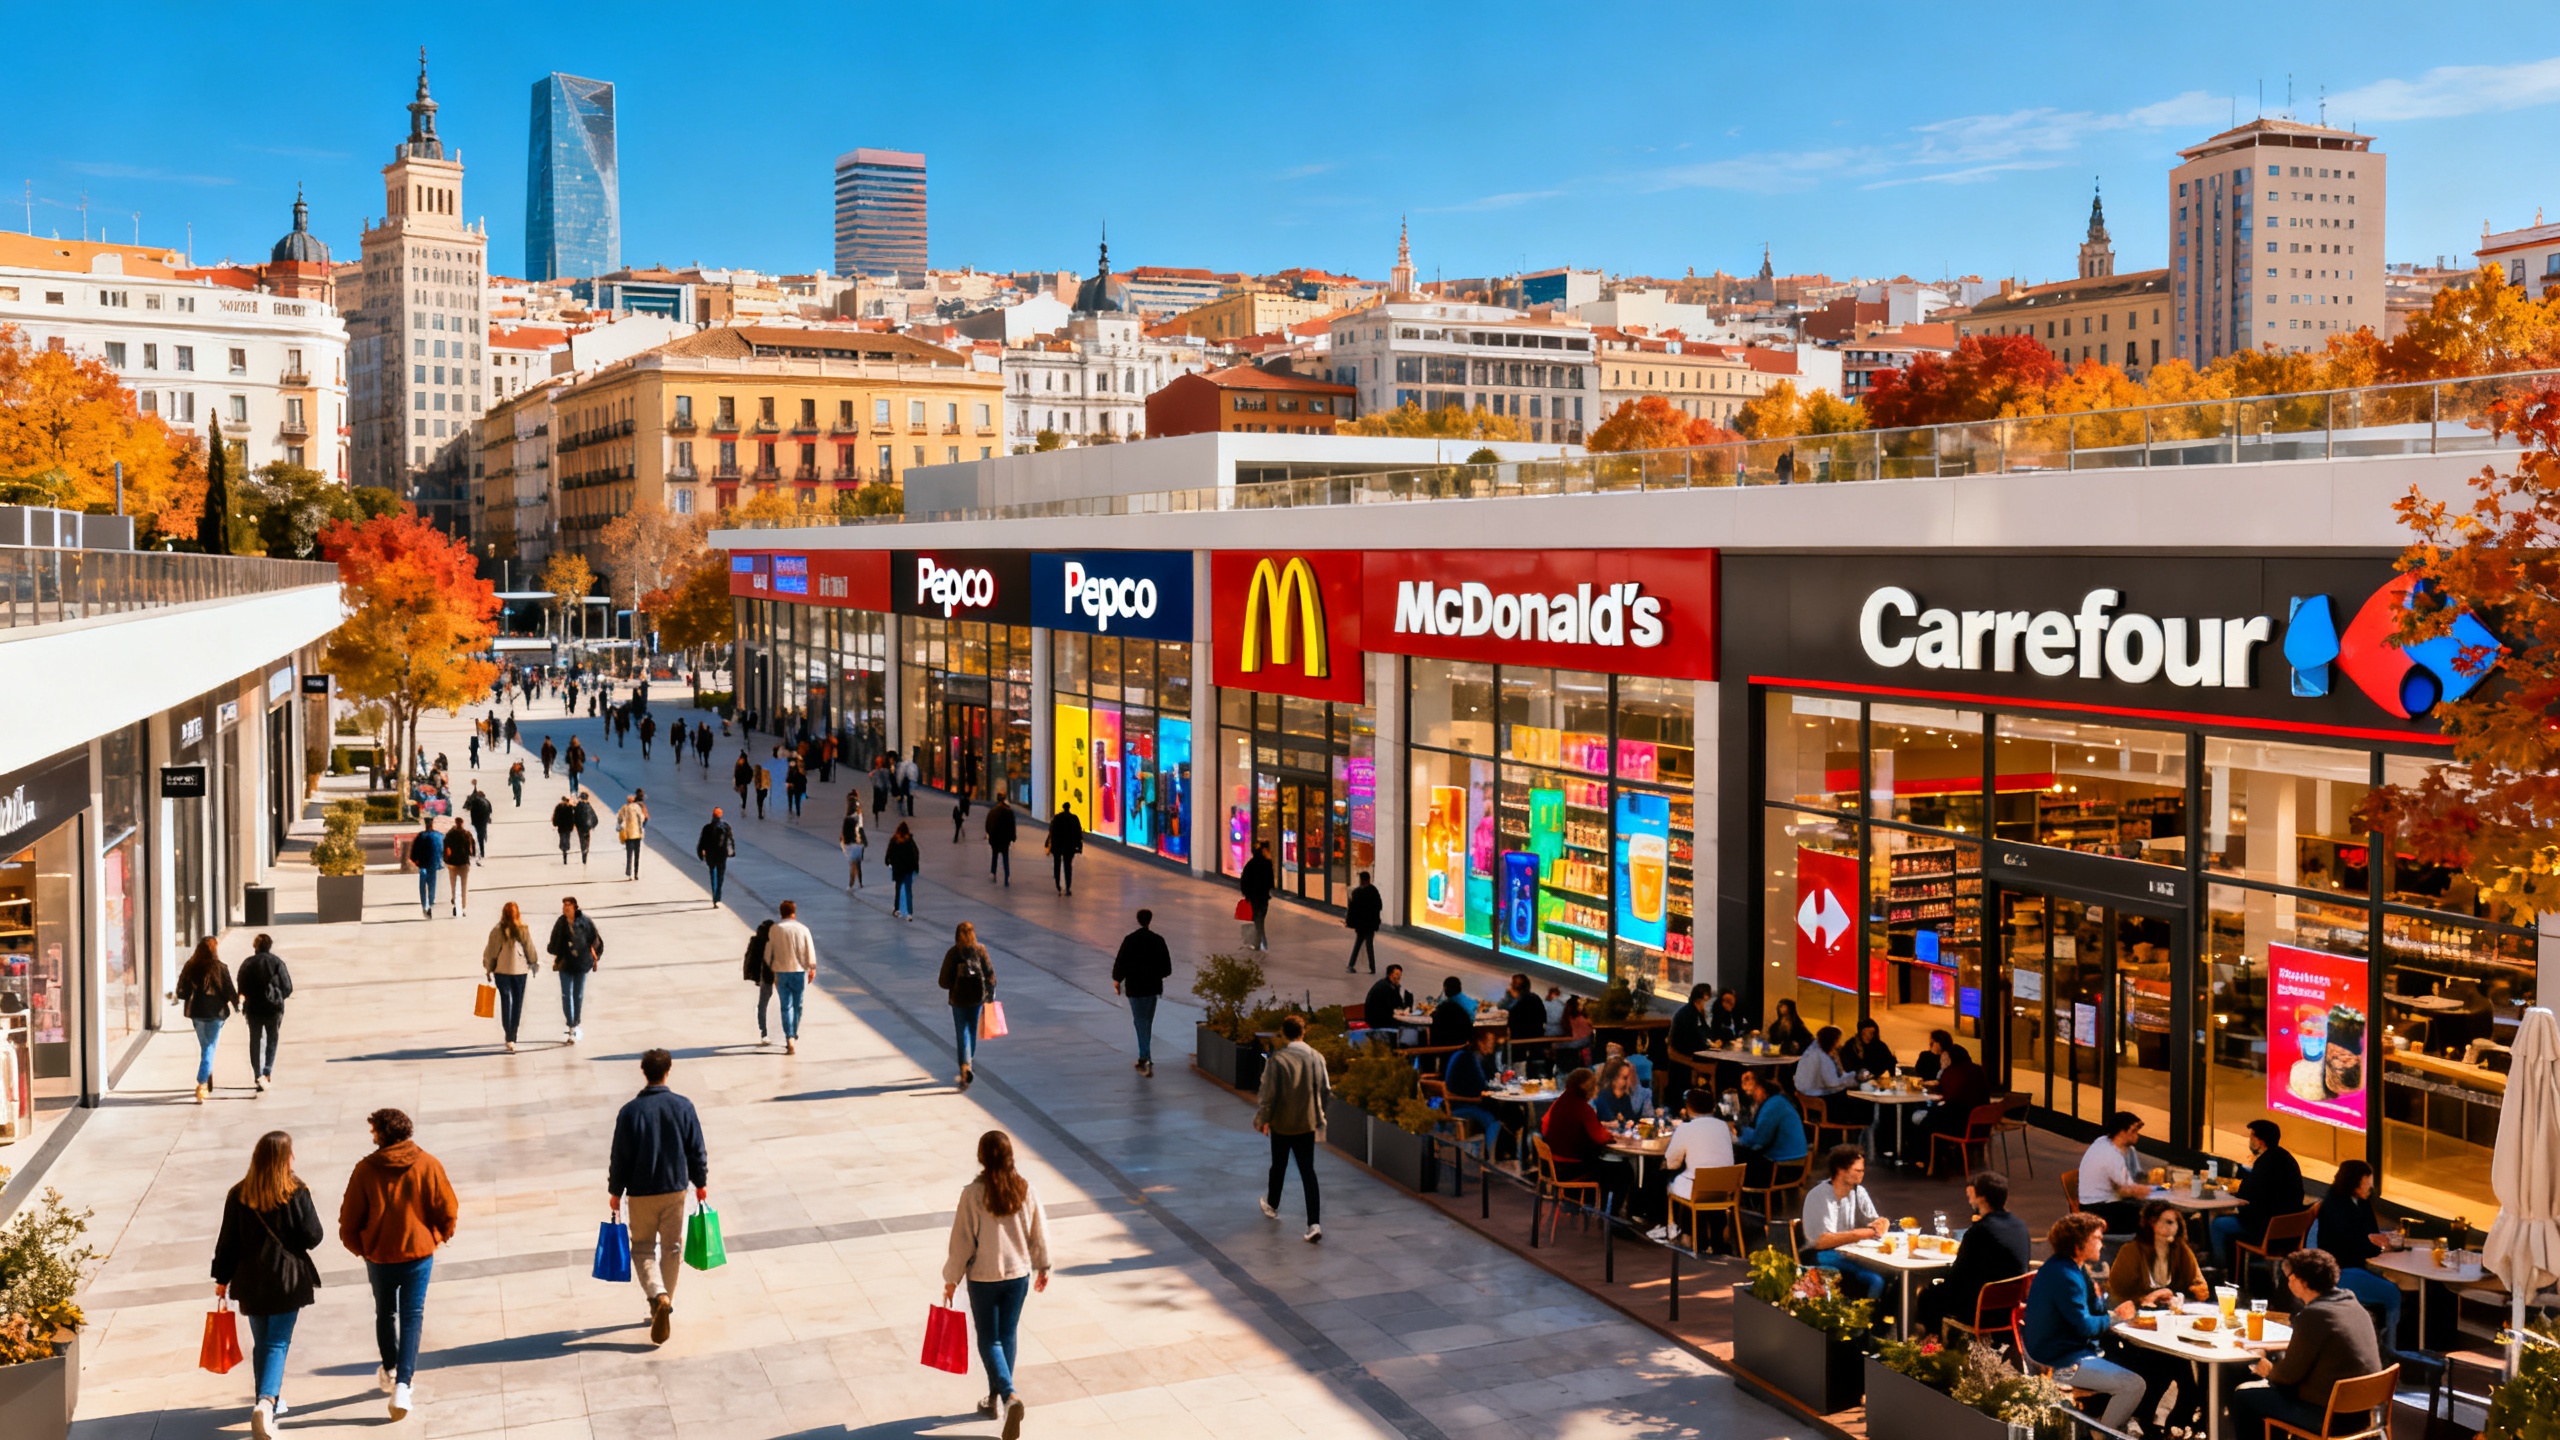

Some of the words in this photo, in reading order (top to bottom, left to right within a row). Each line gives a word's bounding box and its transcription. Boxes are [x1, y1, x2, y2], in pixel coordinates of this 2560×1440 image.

[1064, 561, 1157, 631] Pepco
[1394, 580, 1664, 648] McDonald's
[1859, 586, 2272, 688] Carrefour
